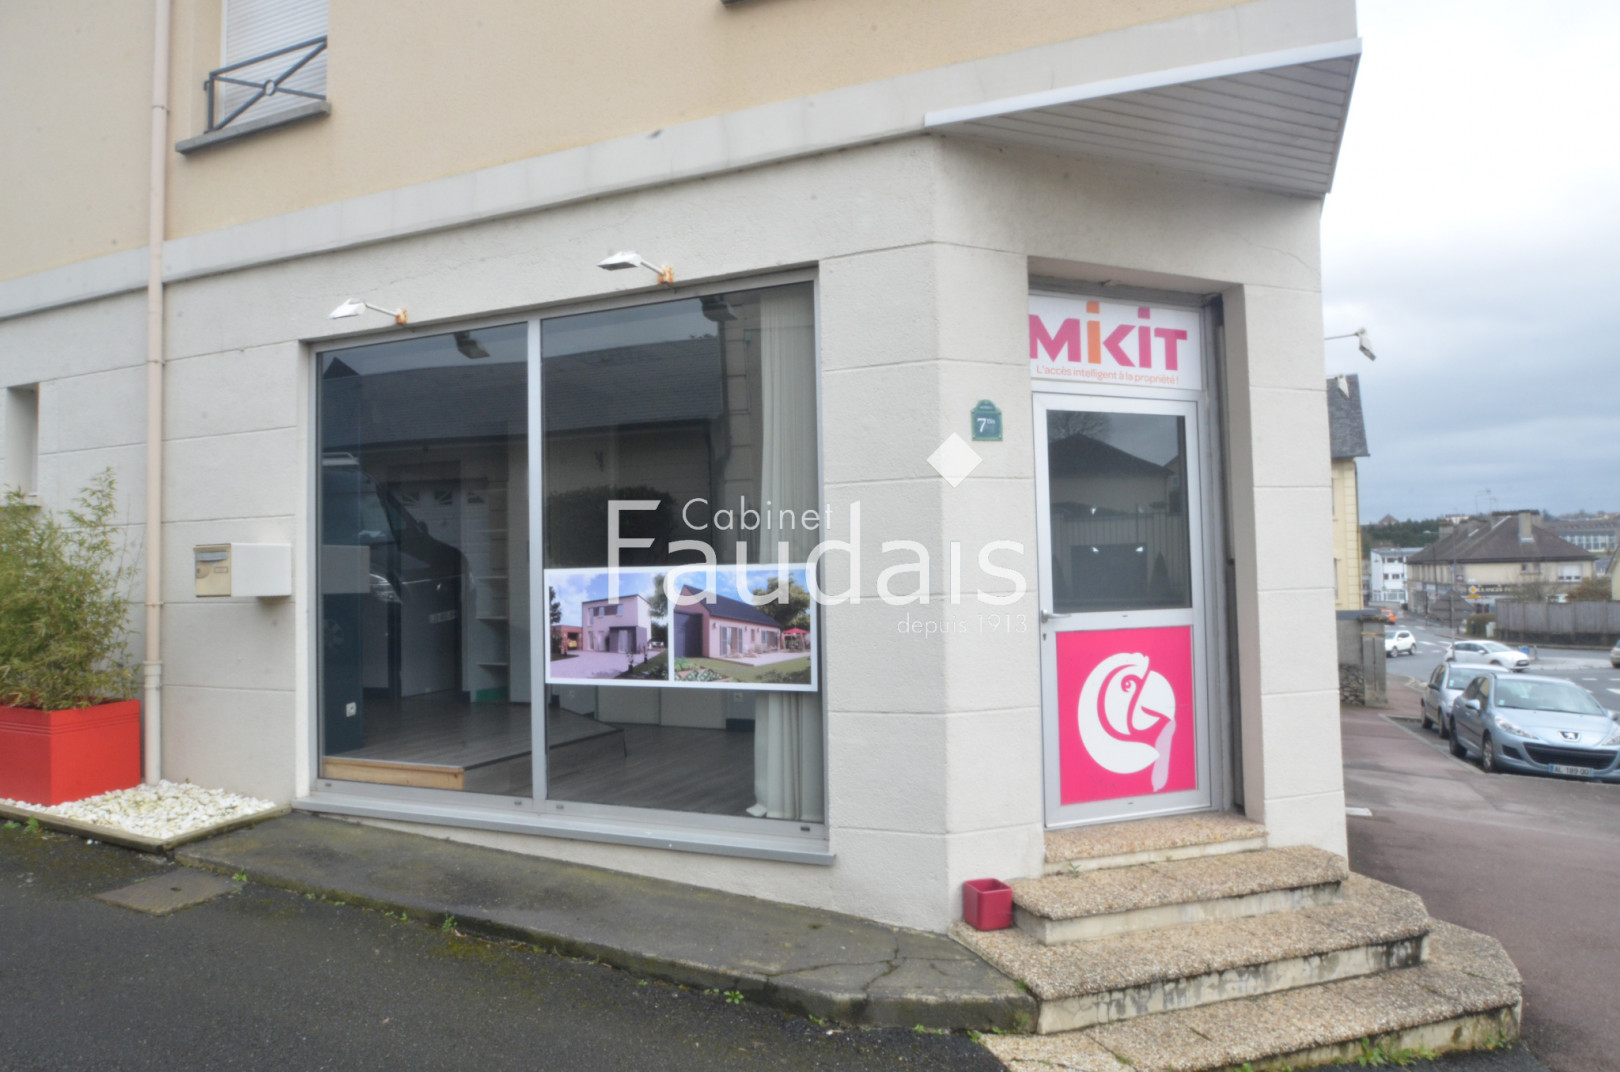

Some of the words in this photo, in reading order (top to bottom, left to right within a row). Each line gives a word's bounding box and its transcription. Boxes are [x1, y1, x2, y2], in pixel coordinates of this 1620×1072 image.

[1036, 365, 1072, 376] L'accès
[1073, 367, 1117, 381] intelligent
[1119, 372, 1125, 380] à
[1125, 373, 1134, 381] la
